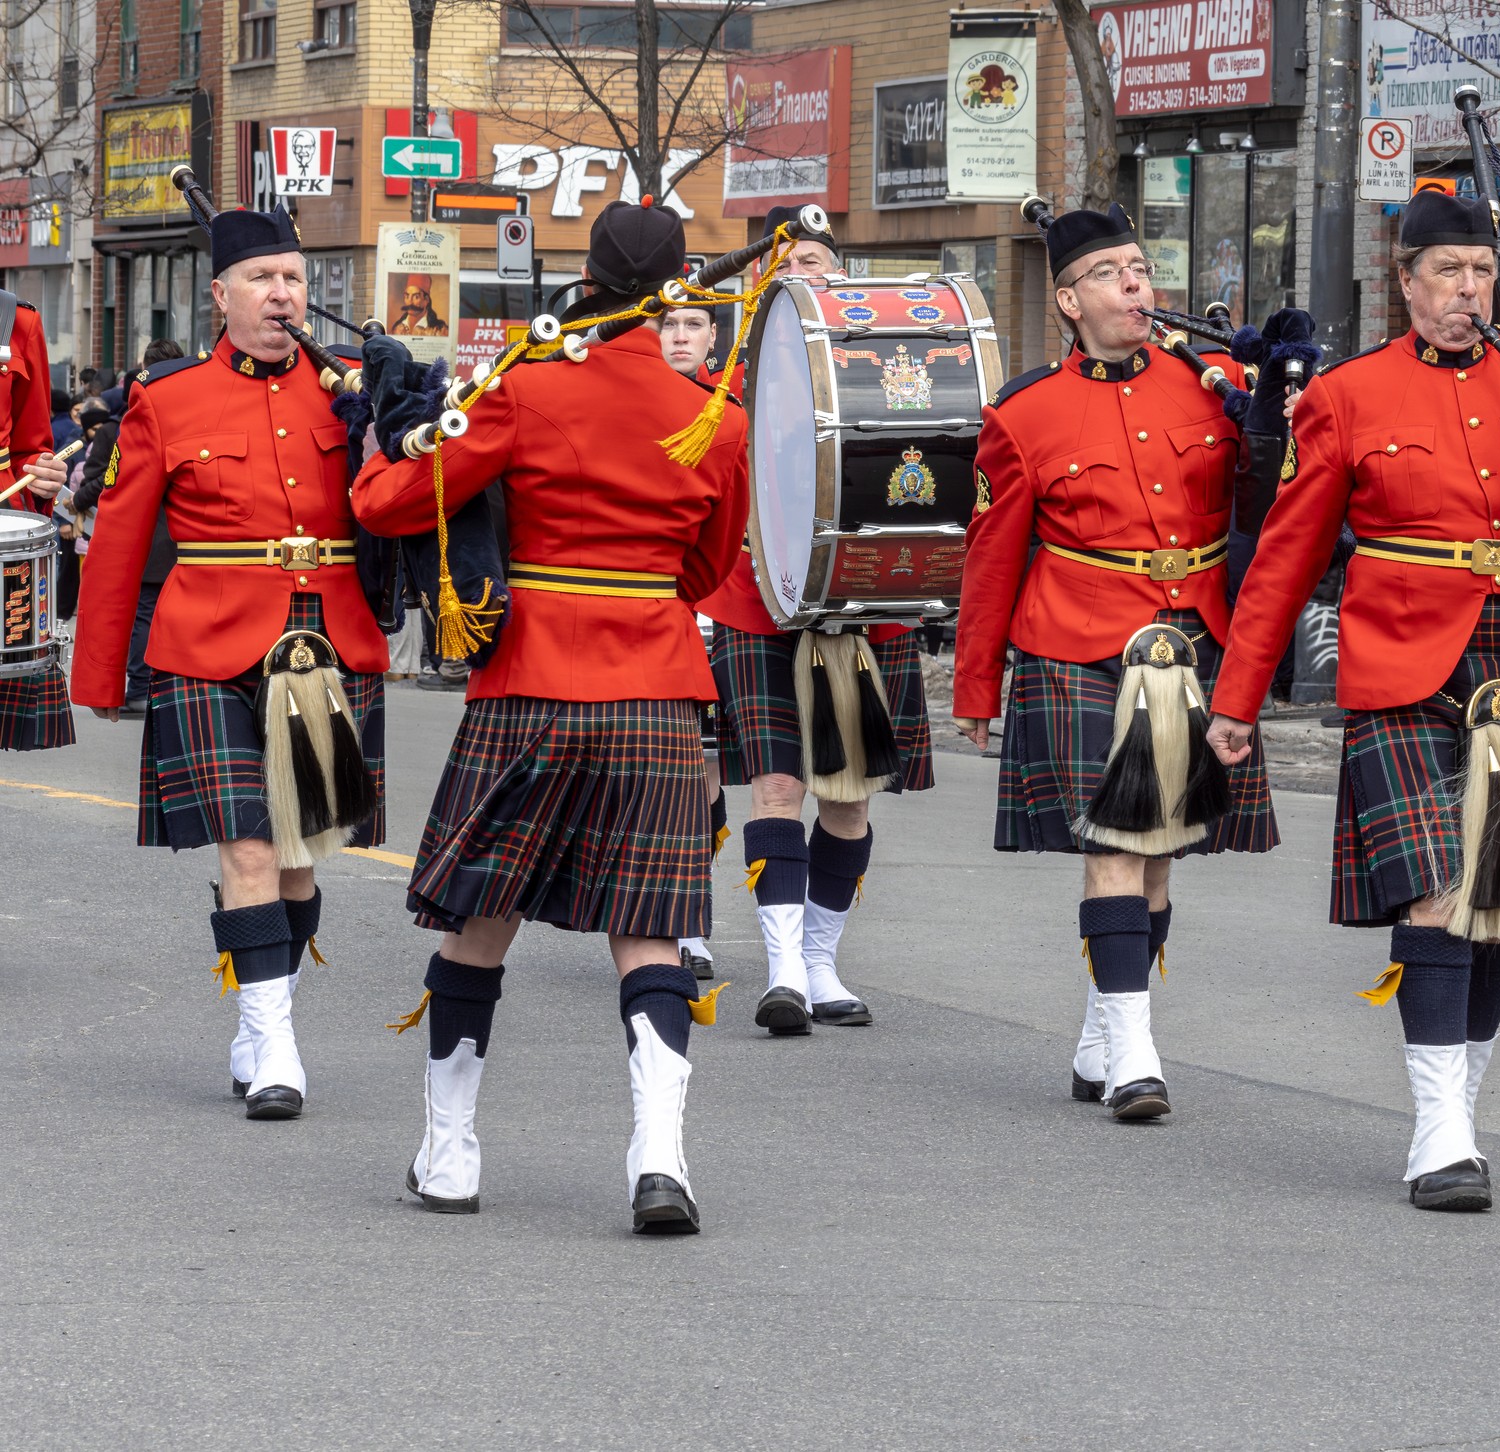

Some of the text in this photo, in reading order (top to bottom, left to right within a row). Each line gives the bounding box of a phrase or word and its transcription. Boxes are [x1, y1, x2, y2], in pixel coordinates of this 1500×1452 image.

[1123, 0, 1254, 58] VAISHNO DHABA
[968, 54, 1017, 70] GARDERIE
[1214, 58, 1229, 74] 100%
[1124, 61, 1191, 86] CUISINE INDIENNE
[1129, 88, 1182, 111] 514-250-3059
[1189, 83, 1247, 107] 514-501-3229
[1431, 79, 1451, 105] POUR
[903, 98, 945, 145] SAYEM
[961, 168, 973, 177] $9
[1390, 170, 1404, 178] VEN
[283, 179, 325, 192] PFK
[491, 143, 702, 219] PFK
[473, 329, 505, 341] PFK
[456, 344, 504, 354] HALTE-
[456, 356, 475, 366] PFK
